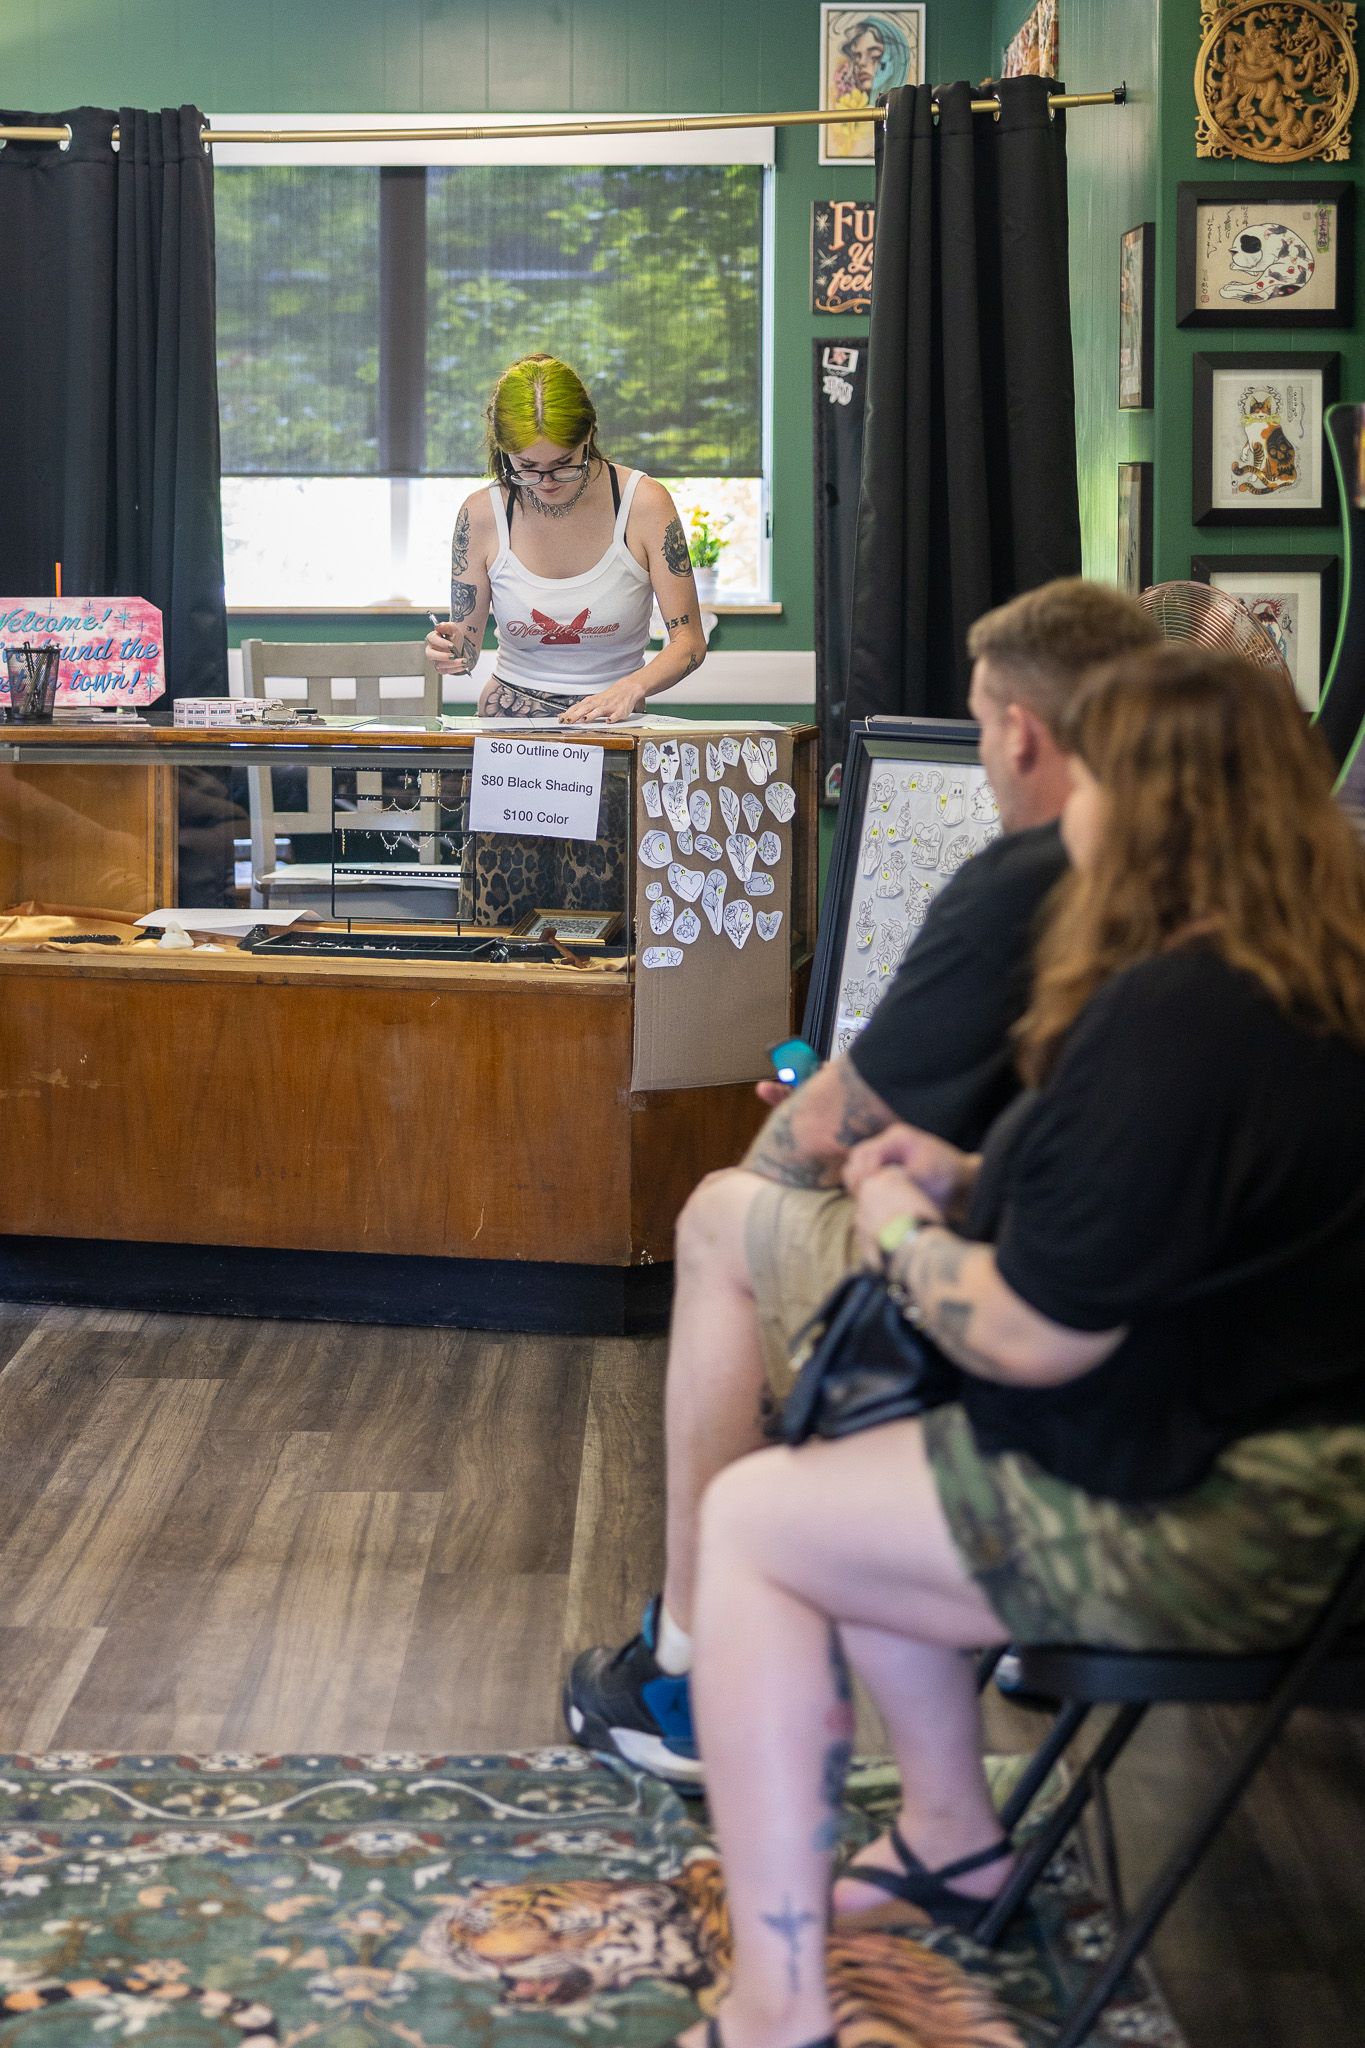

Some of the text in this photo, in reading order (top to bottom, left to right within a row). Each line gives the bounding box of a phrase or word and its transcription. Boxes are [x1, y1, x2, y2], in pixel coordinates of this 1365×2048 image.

[828, 201, 875, 250] FU
[120, 637, 159, 660] the
[70, 669, 140, 694] town!
[490, 741, 590, 762] $60 Outline Only
[481, 774, 593, 796] $80 Black Shading
[503, 808, 569, 825] $100 Color
